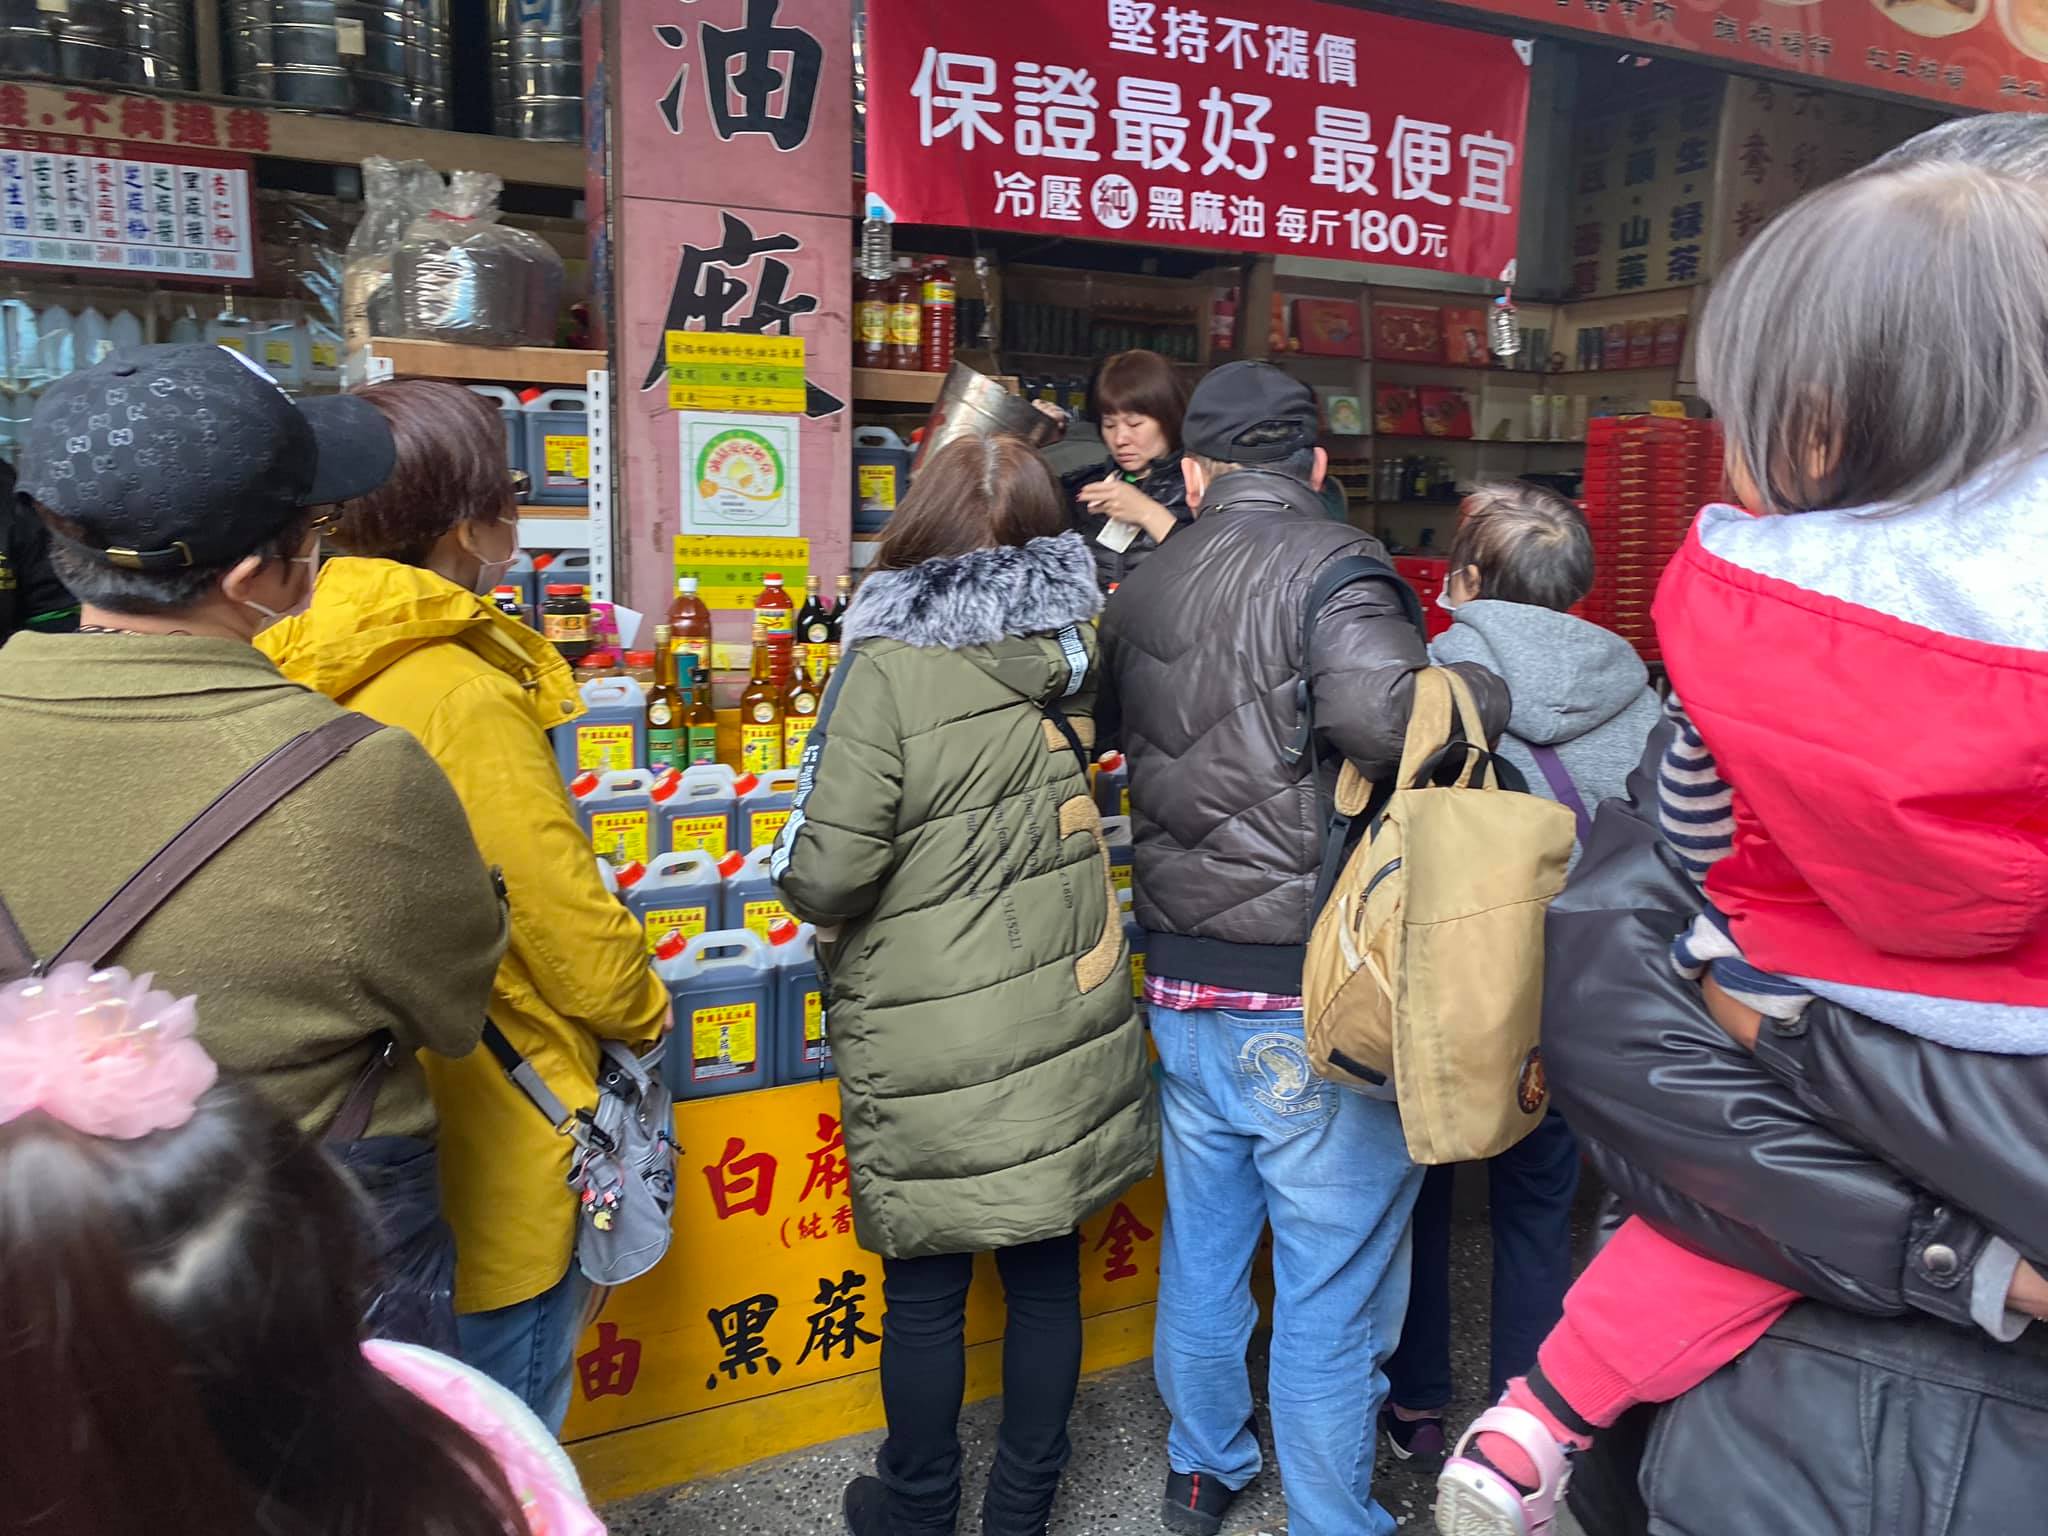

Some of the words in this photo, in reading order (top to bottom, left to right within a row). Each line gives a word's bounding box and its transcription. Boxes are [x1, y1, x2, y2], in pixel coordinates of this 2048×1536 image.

[1107, 0, 1357, 88] 堅持不漲價
[993, 170, 1266, 238] 冷壓純黑麻油
[1275, 204, 1448, 258] 每斤180元
[705, 1269, 882, 1390] 黑麻
